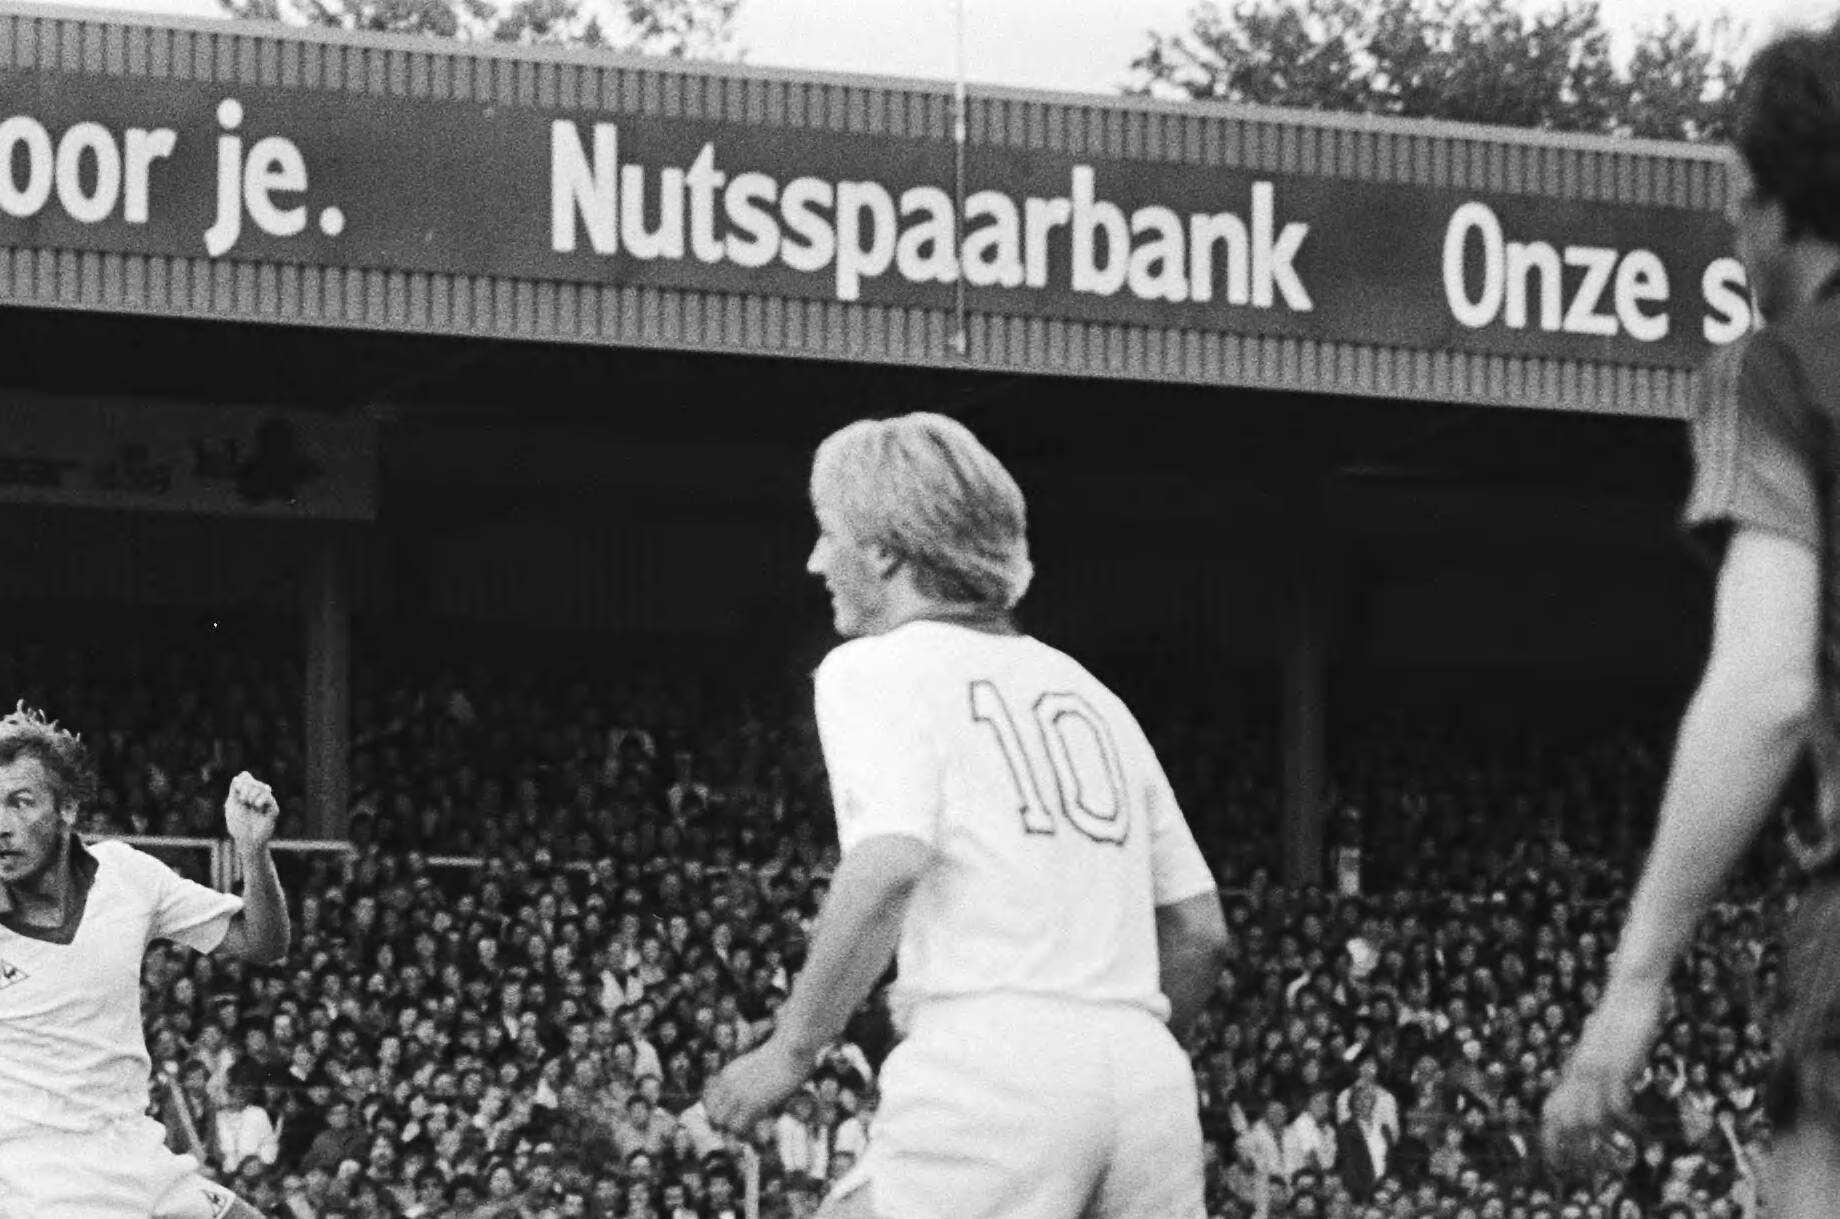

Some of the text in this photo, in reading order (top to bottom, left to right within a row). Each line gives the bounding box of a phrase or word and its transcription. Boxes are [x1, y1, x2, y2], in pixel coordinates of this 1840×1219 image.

[204, 98, 346, 257] je.
[551, 119, 1313, 314] Nutsspaarbank
[1442, 201, 1766, 344] Onze s
[968, 679, 1132, 847] 10
